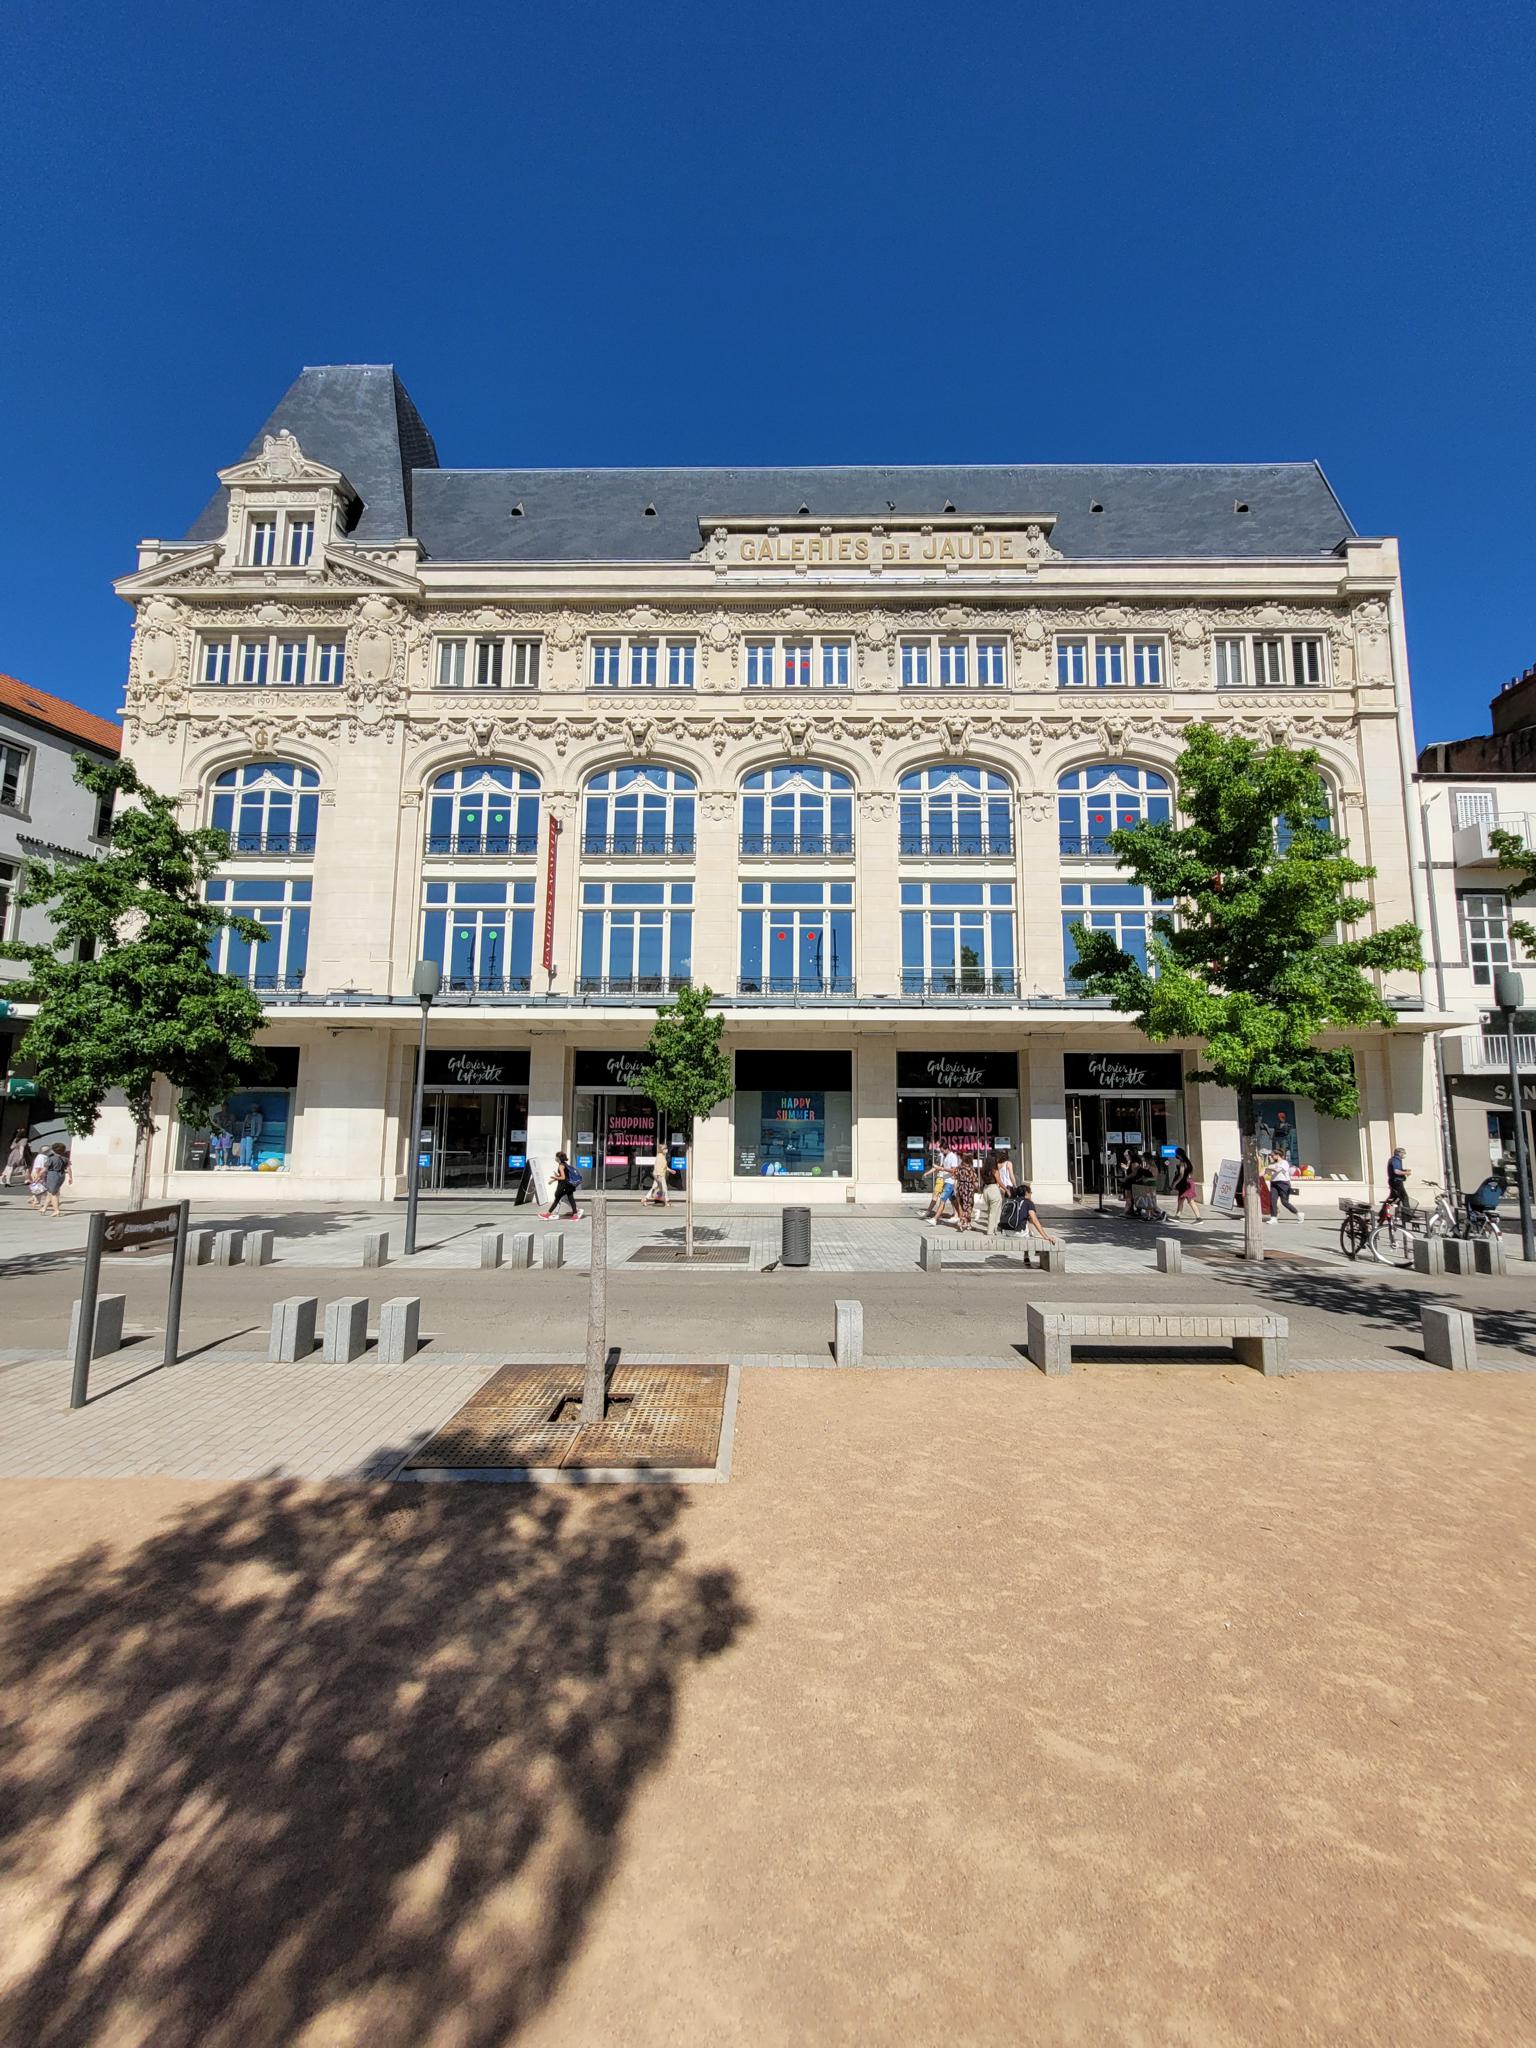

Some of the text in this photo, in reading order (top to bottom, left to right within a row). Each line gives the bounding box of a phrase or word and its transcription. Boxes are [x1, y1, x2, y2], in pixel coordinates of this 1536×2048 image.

[739, 537, 1014, 561] GALERIES DE JAUDE
[257, 697, 274, 706] 1907
[16, 833, 44, 847] BNP
[448, 1054, 486, 1072] Galeries
[927, 1057, 966, 1076] Galeries
[1088, 1057, 1128, 1076] Galeries
[457, 1064, 504, 1085] Lafayette
[937, 1067, 986, 1088] Lafayette
[1099, 1067, 1148, 1088] Lafayette
[781, 1097, 811, 1109] HAPPY
[609, 1116, 654, 1129] SHOPPING
[776, 1110, 815, 1121] SUMMER
[615, 1134, 654, 1145] DISTANCE
